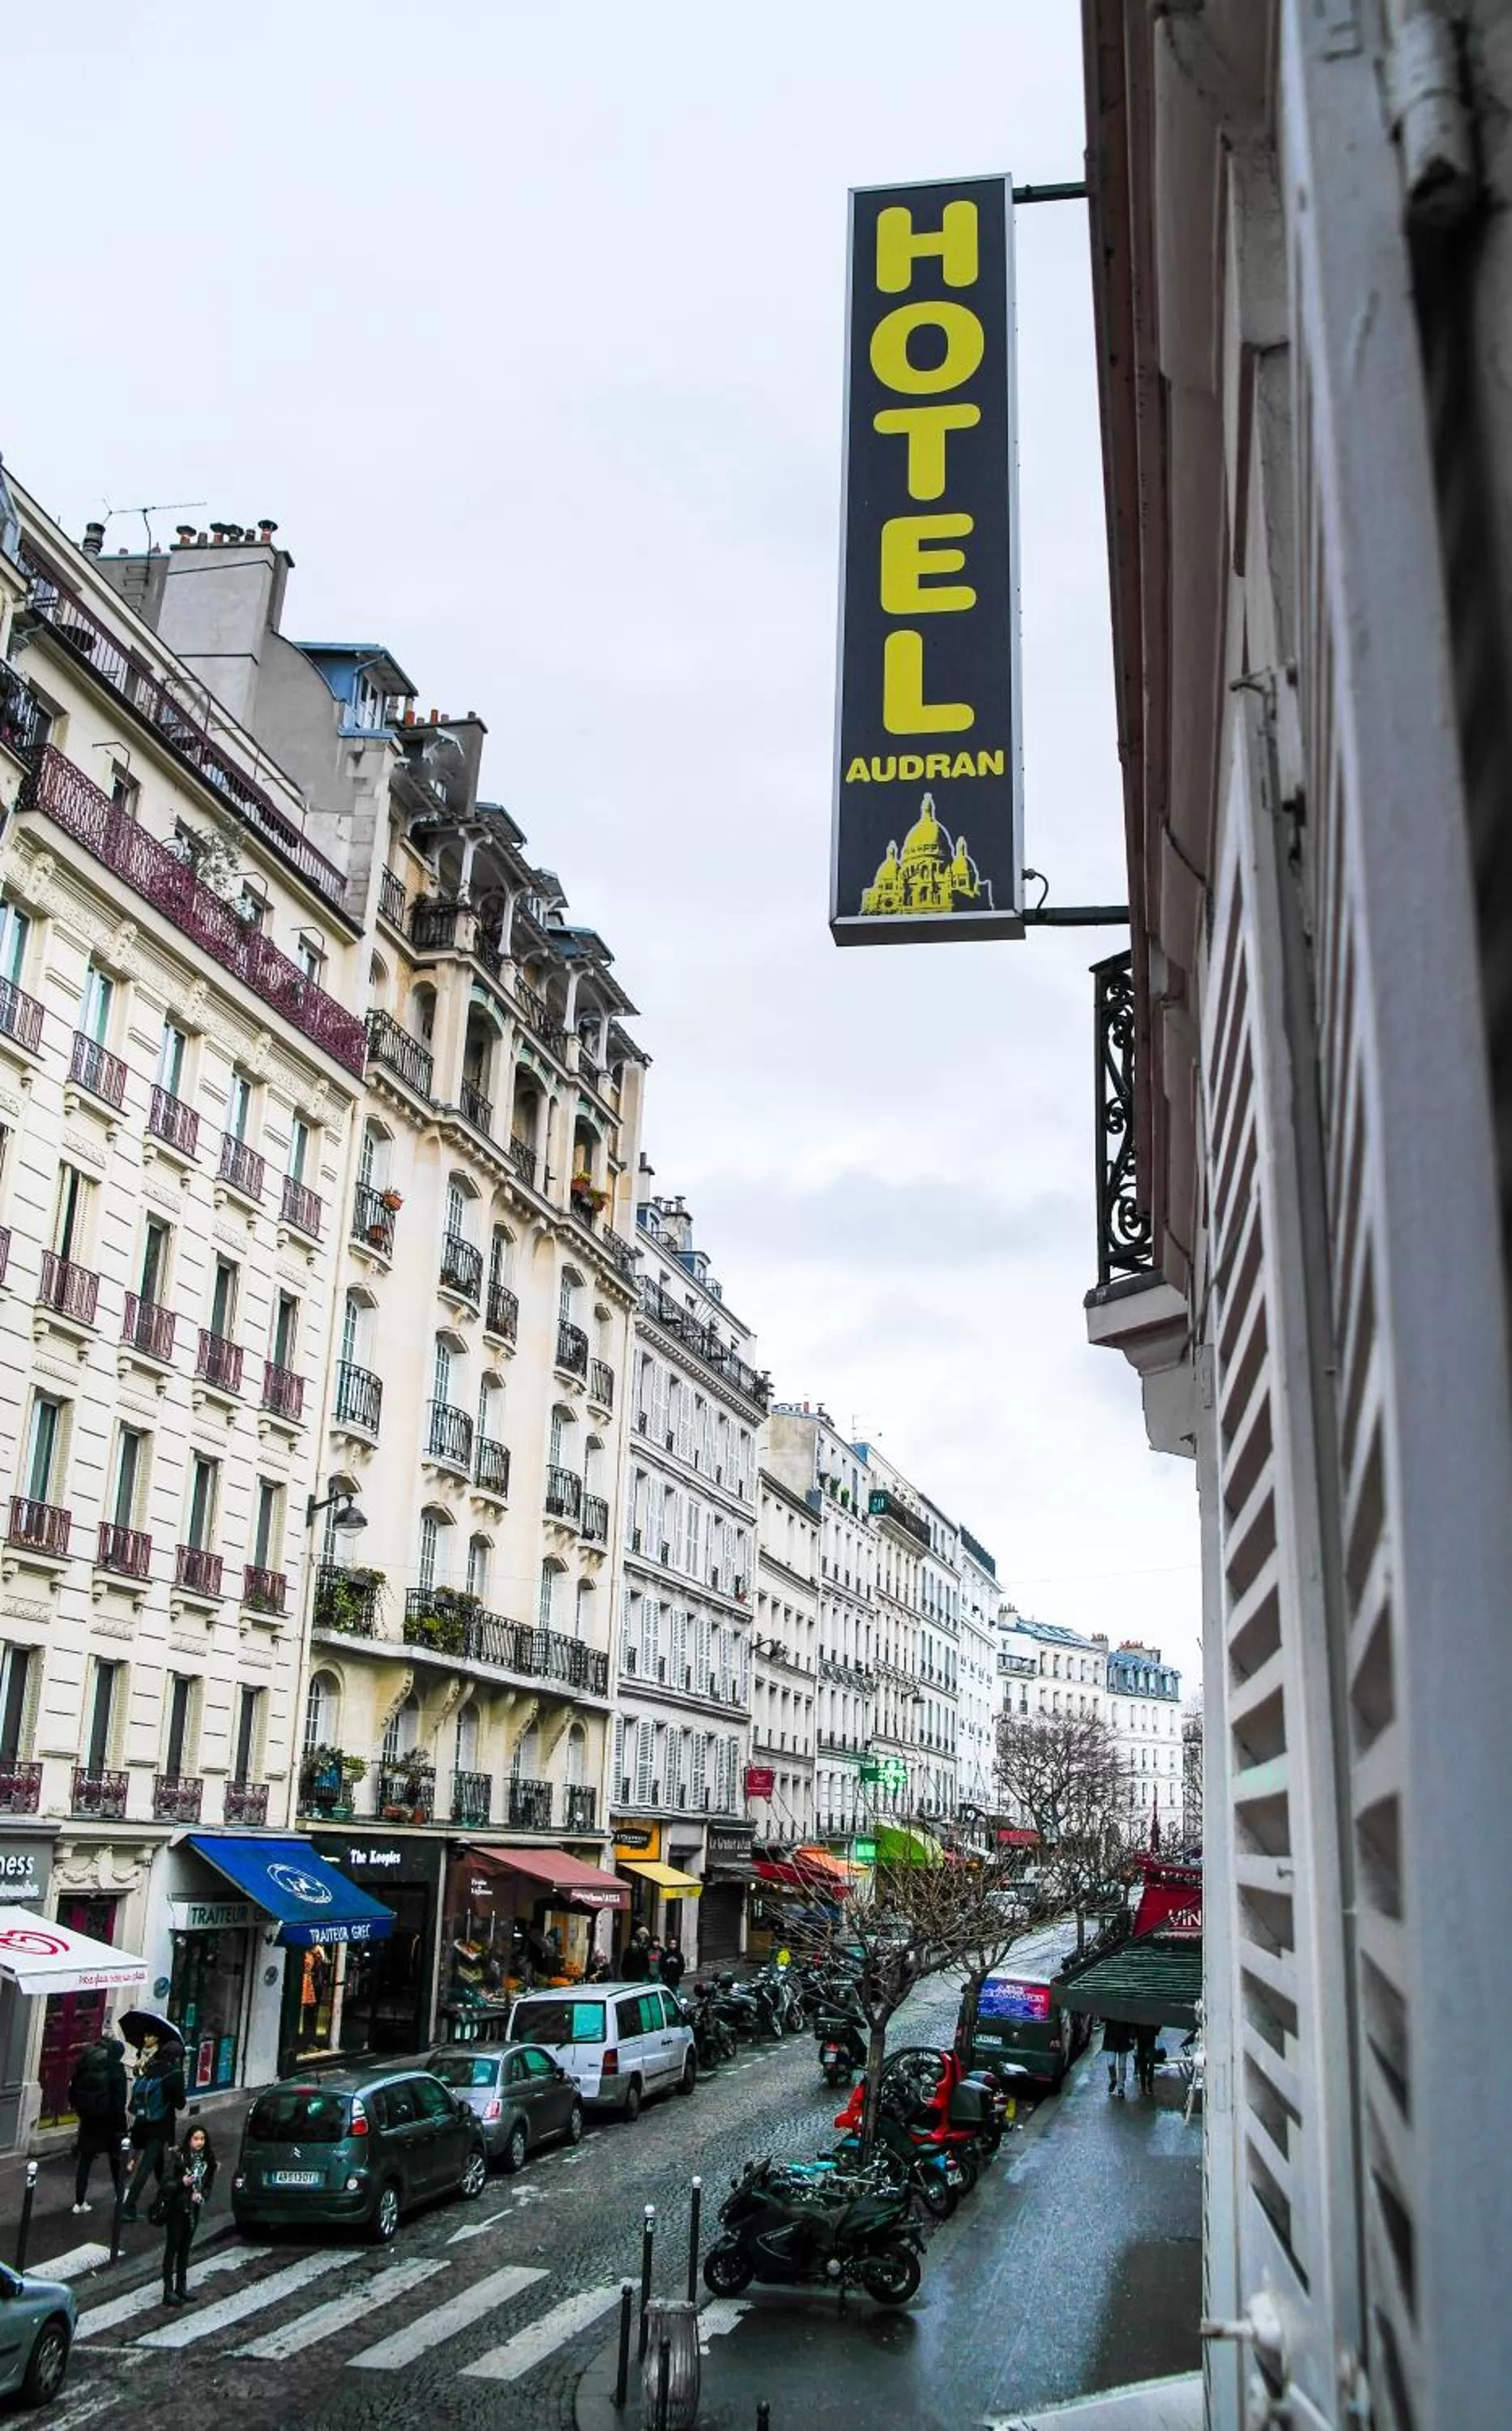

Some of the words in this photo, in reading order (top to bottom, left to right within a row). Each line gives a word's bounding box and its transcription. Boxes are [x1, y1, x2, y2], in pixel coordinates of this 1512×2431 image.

[869, 200, 985, 733] HOTEL
[845, 750, 1006, 784] AUDRAN
[350, 1849, 367, 1865] The
[369, 1850, 401, 1868] Kooples
[191, 1906, 247, 1925] TRAITEUR
[309, 1927, 348, 1944] TRAITEUR
[351, 1924, 372, 1939] GREC
